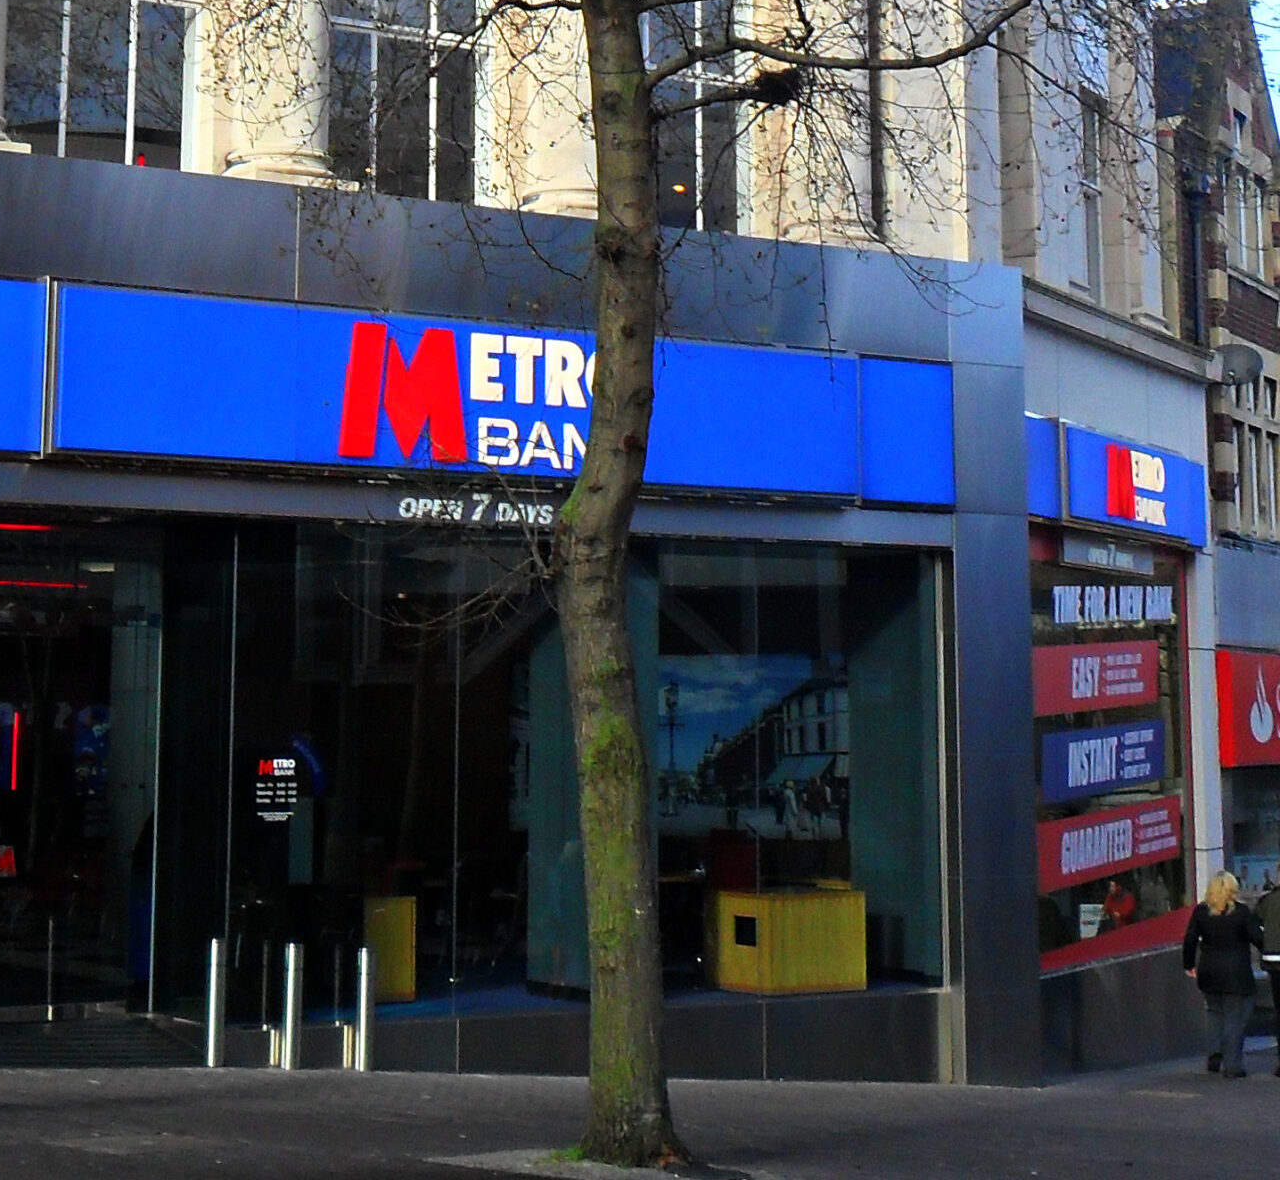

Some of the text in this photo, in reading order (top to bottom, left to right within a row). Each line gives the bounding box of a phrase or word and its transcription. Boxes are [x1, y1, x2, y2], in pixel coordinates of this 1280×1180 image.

[338, 321, 597, 464] METR
[477, 416, 586, 471] BAN
[398, 492, 554, 525] OPEN 7 DAYS
[1106, 444, 1167, 520] METRO
[1053, 585, 1082, 624] TIME
[1084, 585, 1105, 623] FOR
[1108, 585, 1117, 621] A
[1071, 655, 1100, 699] EASY
[1067, 736, 1118, 787] INSTANT
[1061, 818, 1133, 875] GUARANTEED
